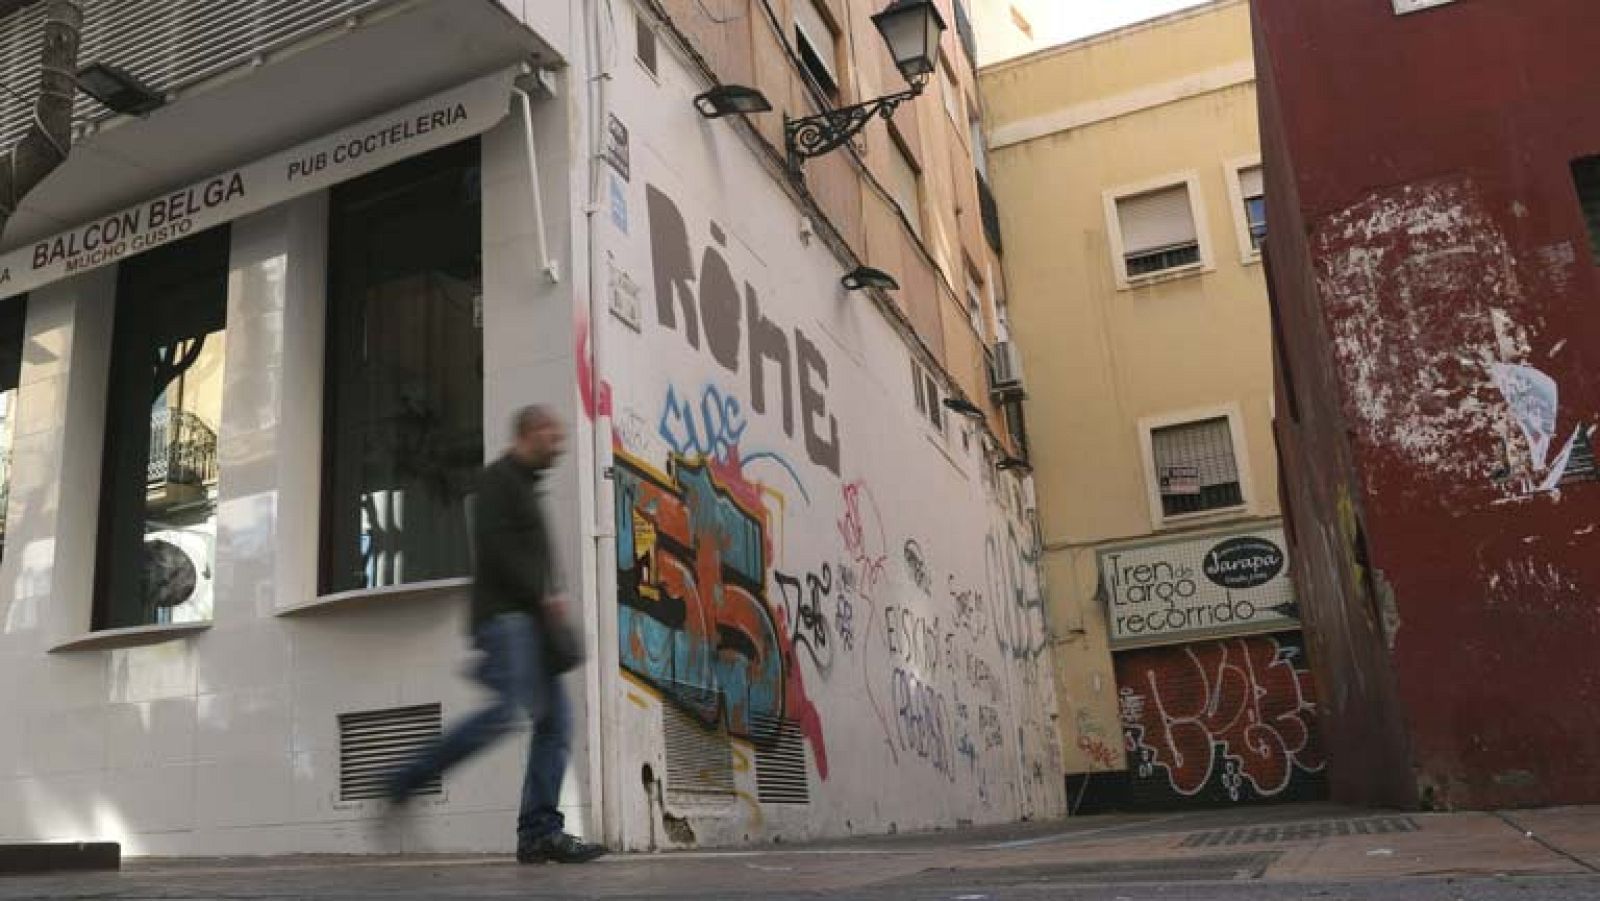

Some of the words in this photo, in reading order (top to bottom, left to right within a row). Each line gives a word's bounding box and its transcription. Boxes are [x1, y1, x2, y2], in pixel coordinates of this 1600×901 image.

[287, 152, 327, 181] PUB
[333, 103, 467, 163] COCTELERIA
[32, 209, 140, 269] BALCON
[148, 172, 244, 228] BELGA
[66, 242, 126, 271] MUCHO
[132, 218, 192, 250] GUSTO
[1109, 555, 1173, 586] Tren
[1117, 589, 1255, 634] recorrido
